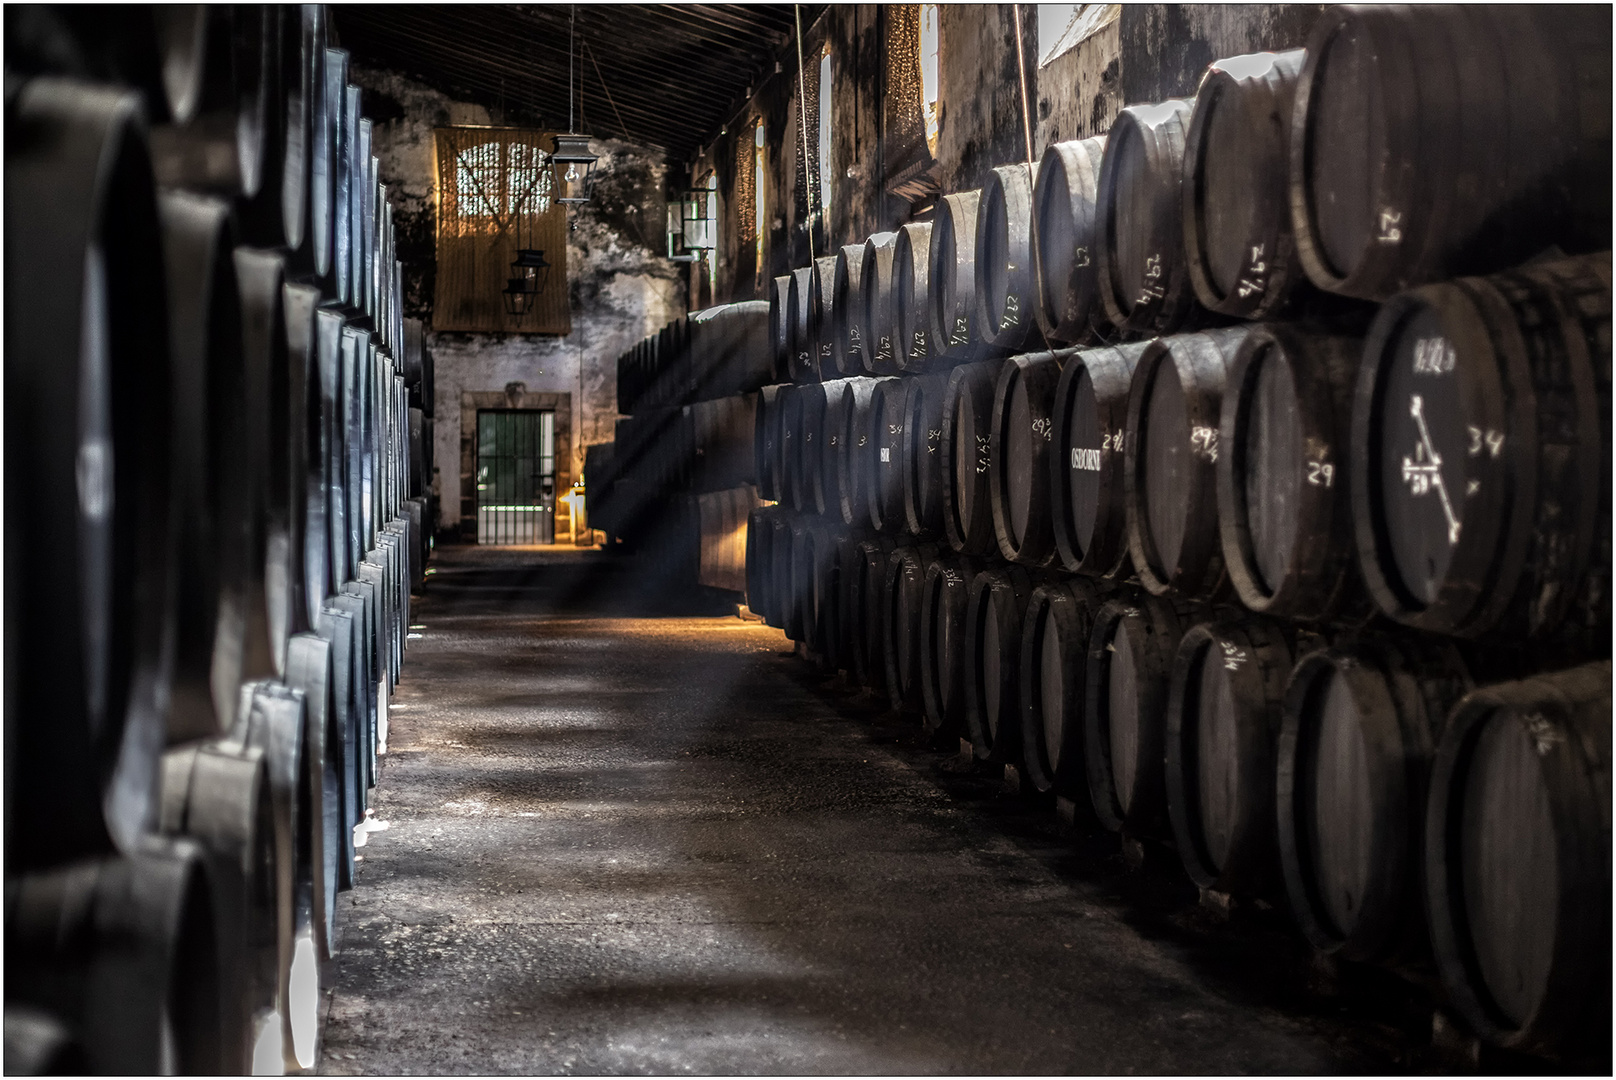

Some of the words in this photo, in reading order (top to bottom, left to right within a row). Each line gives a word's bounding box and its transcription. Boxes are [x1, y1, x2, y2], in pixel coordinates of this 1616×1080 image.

[1377, 211, 1401, 241] 29
[1467, 423, 1505, 459] 34
[1308, 461, 1335, 488] 29
